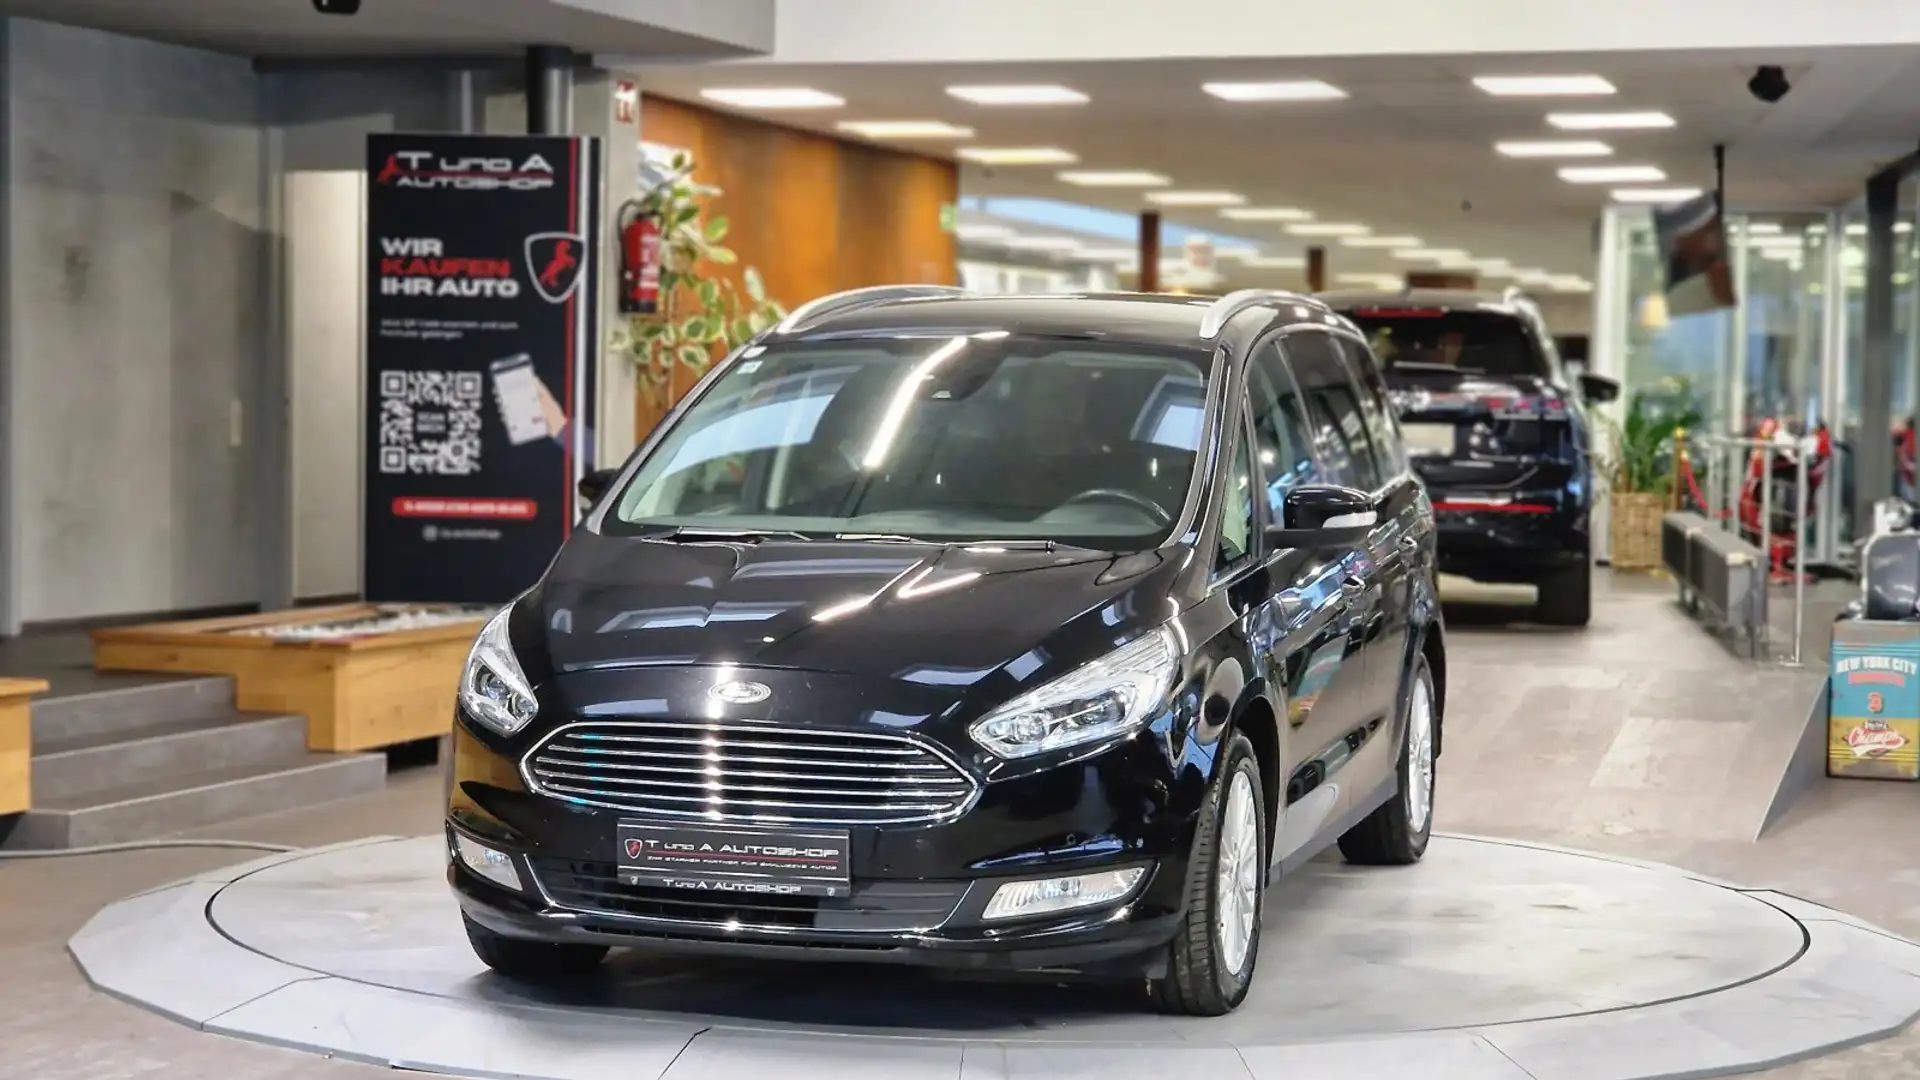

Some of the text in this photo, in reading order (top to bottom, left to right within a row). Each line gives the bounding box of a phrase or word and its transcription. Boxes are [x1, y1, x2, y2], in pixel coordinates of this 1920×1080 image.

[396, 151, 433, 171] T
[519, 153, 554, 173] A
[396, 176, 554, 190] AUTOSHOP
[381, 237, 443, 257] WIR
[381, 258, 511, 277] KAUFEN
[381, 277, 520, 298] IHR AUTO
[1836, 655, 1917, 675] NEW YORK CITY
[645, 840, 660, 849] T
[699, 843, 713, 852] A
[719, 844, 839, 858] AUTOSHOP
[663, 879, 673, 888] T
[696, 881, 708, 889] A
[713, 882, 801, 894] AUTOSHOP
